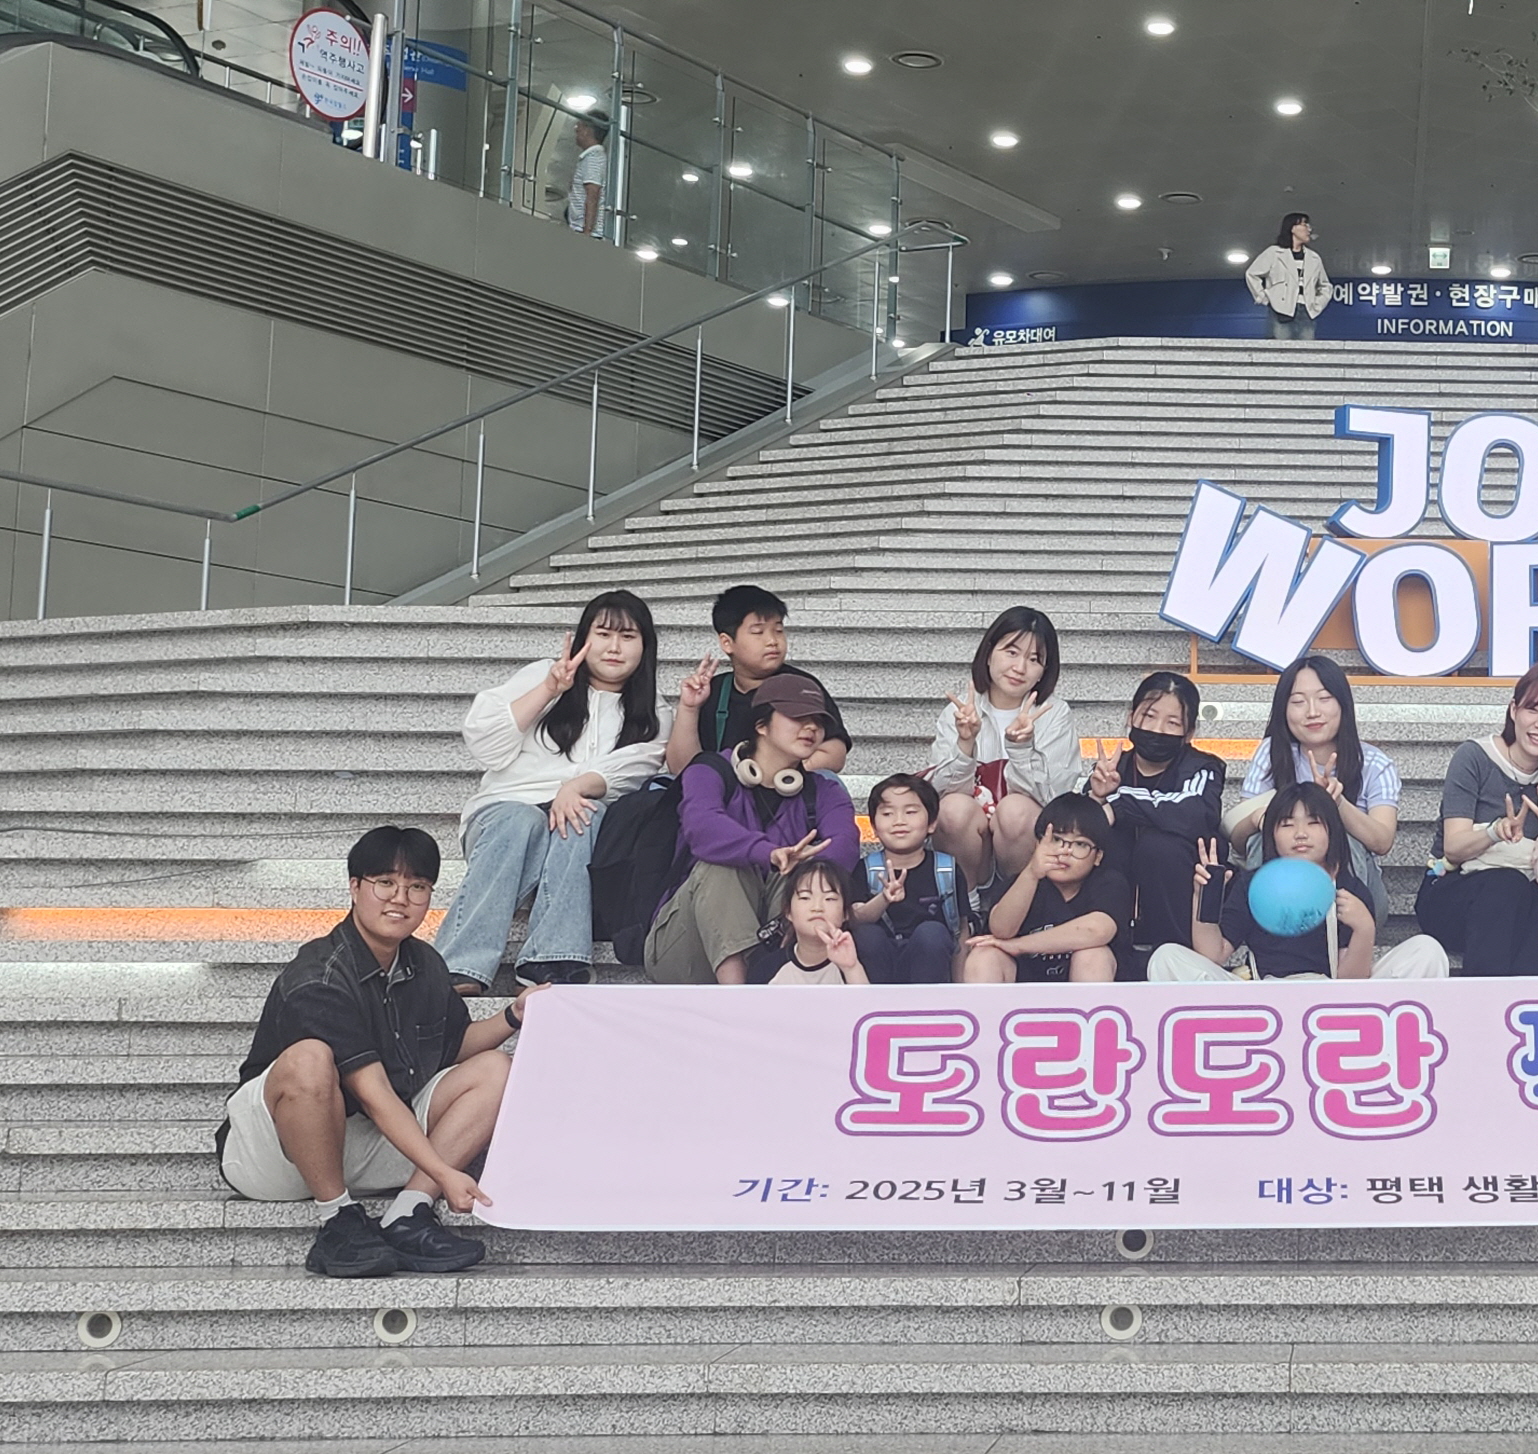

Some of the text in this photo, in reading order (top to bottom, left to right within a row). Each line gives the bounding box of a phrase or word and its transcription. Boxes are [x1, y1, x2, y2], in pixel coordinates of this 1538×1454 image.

[325, 28, 362, 57] 주의!!
[319, 48, 365, 75] 역주행사고
[991, 326, 1056, 347] 유모차대여
[1377, 318, 1513, 338] INFORMATION
[835, 1001, 1448, 1142] 도란도란
[731, 1177, 1181, 1206] 기간: 2025년 3월~11월
[1256, 1177, 1349, 1205] 대상:
[1365, 1175, 1445, 1205] 평택
